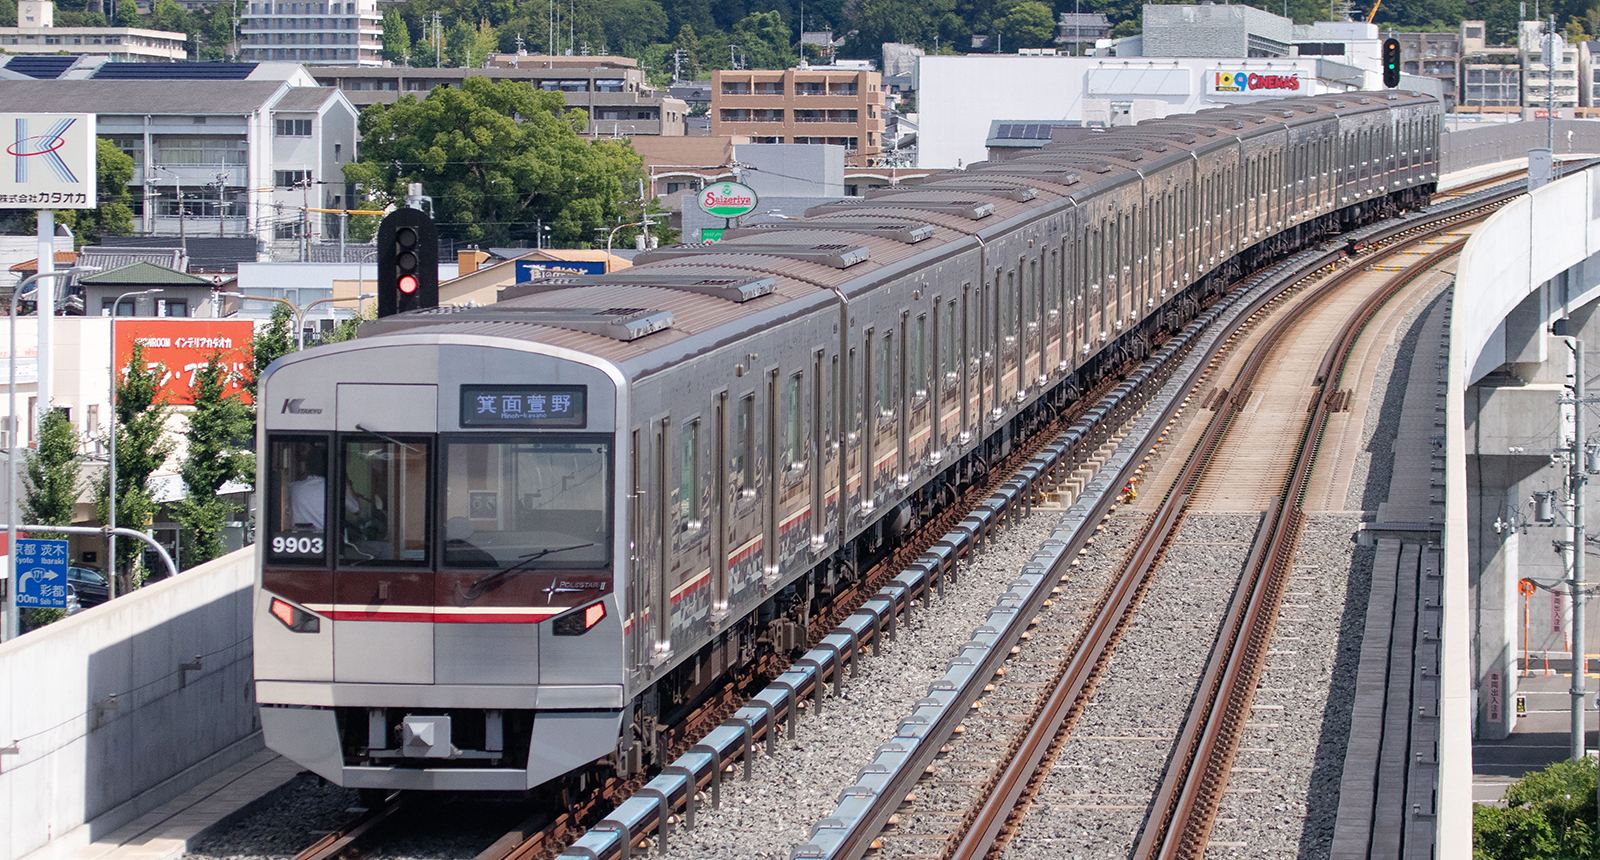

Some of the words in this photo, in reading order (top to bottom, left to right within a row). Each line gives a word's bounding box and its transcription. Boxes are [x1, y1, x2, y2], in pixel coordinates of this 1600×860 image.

[1215, 72, 1248, 92] 109
[1248, 73, 1299, 90] CINEMAS
[0, 192, 87, 203] 株式会社カタオカ
[704, 192, 751, 207] Saizeriya
[281, 398, 323, 414] KITAKYU
[477, 394, 571, 414] 箕面萱野
[15, 543, 36, 556] 京都
[41, 544, 65, 556] 茨木
[272, 536, 324, 554] 9903
[41, 557, 65, 565] Ibaraki
[33, 570, 43, 579] 171
[41, 585, 65, 597] 彩都
[17, 594, 38, 604] 00m
